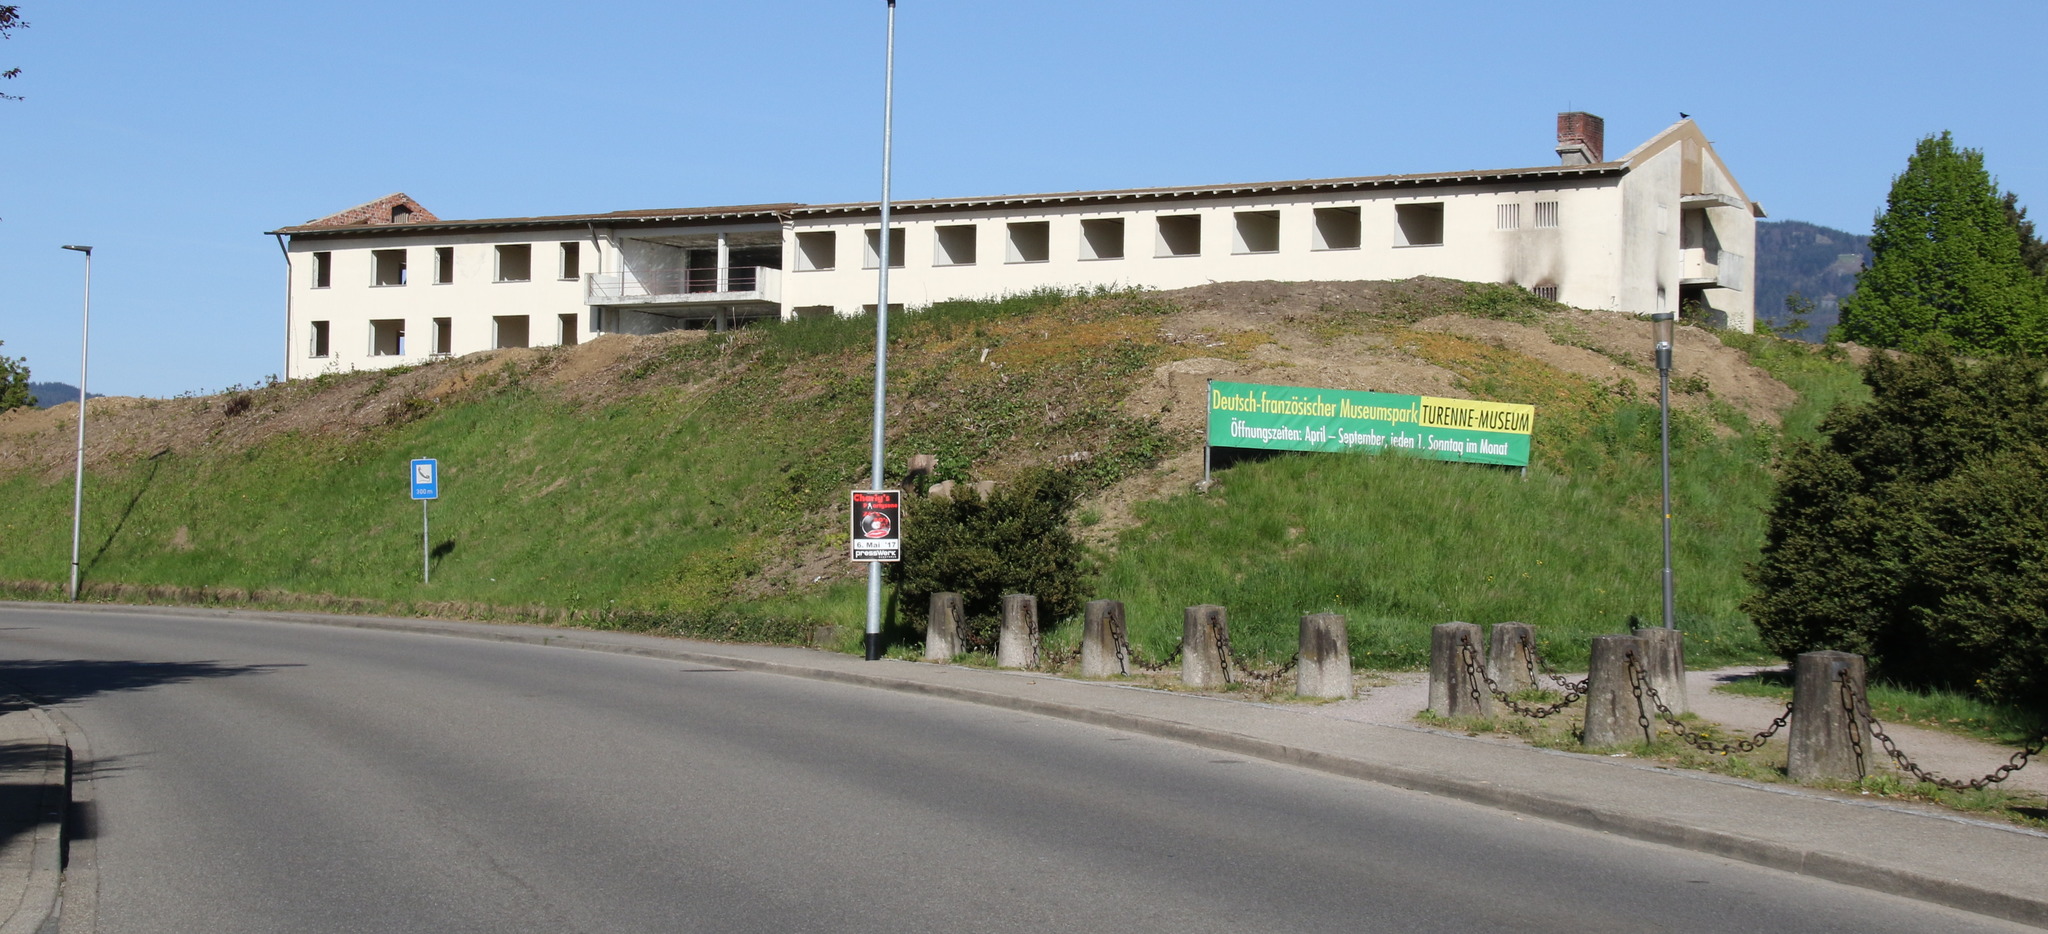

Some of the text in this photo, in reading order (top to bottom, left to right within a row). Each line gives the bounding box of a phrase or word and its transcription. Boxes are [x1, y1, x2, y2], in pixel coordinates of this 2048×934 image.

[1212, 389, 1418, 426] Deutsch-französischer Museumspark
[1422, 404, 1530, 432] TURENNE-MUSEUM
[1230, 417, 1302, 443] Öffnungszeiten:
[1305, 425, 1326, 445] April
[1338, 427, 1387, 448] September,
[1417, 433, 1425, 449] 1.
[1428, 434, 1464, 455] Sonntag
[1466, 439, 1477, 454] im
[1480, 440, 1508, 456] Monat
[853, 494, 890, 503] Charly's
